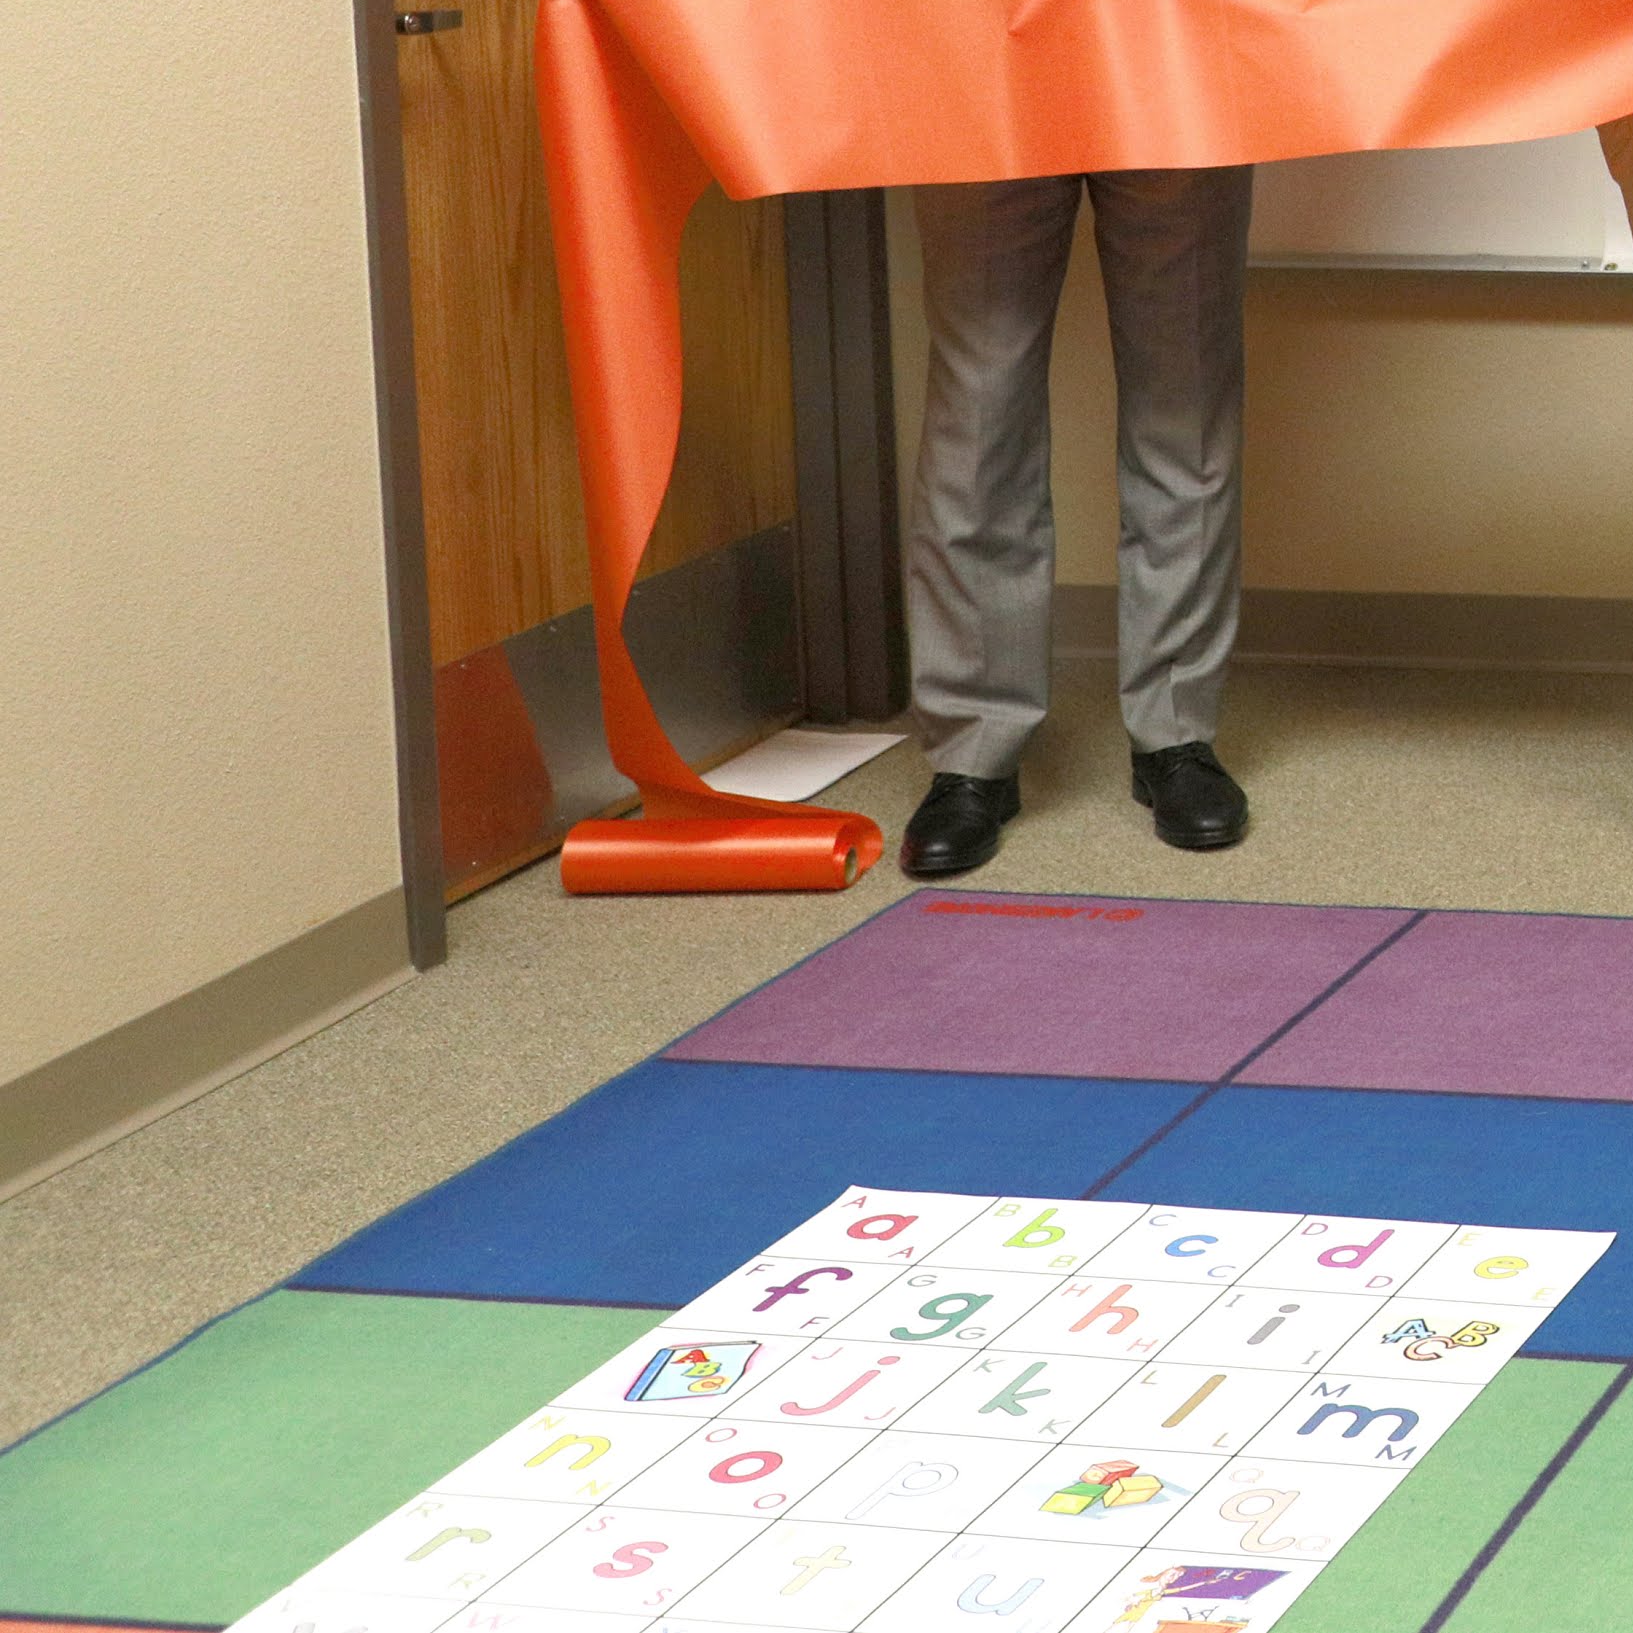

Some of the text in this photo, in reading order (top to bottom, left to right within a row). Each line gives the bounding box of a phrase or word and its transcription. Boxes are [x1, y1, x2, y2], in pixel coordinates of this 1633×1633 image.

[841, 1195, 867, 1208] A
[993, 1203, 1022, 1217] B
[846, 1213, 919, 1241] a
[1002, 1208, 1066, 1248] b
[1149, 1213, 1178, 1227] C
[1300, 1222, 1329, 1235] D
[1164, 1234, 1219, 1257] c
[1457, 1232, 1481, 1247] E
[888, 1246, 914, 1258] A
[1317, 1229, 1395, 1269] d
[1048, 1254, 1078, 1267] B
[1473, 1255, 1529, 1280] e
[745, 1263, 775, 1276] F
[1207, 1265, 1236, 1278] C
[752, 1266, 854, 1312] f
[907, 1274, 938, 1287] G
[1365, 1275, 1394, 1289] D
[1061, 1283, 1093, 1297] H
[1531, 1287, 1557, 1301] E
[1069, 1283, 1140, 1335] h
[1225, 1293, 1245, 1308] I
[800, 1316, 830, 1329] F
[889, 1292, 994, 1341] g
[1247, 1304, 1300, 1345] i
[955, 1327, 987, 1340] G
[1451, 1320, 1501, 1348] B
[811, 1346, 844, 1360] J
[1126, 1337, 1159, 1353] H
[1403, 1335, 1463, 1362] C
[973, 1358, 1006, 1373] K
[1301, 1350, 1322, 1365] I
[780, 1355, 901, 1416] j
[1140, 1370, 1158, 1385] L
[978, 1361, 1051, 1416] k
[1310, 1381, 1352, 1398] M
[864, 1406, 896, 1420] J
[528, 1415, 567, 1431] N
[1037, 1418, 1072, 1435] K
[1296, 1402, 1420, 1442] m
[705, 1427, 738, 1443] O
[1212, 1432, 1229, 1448] L
[524, 1434, 612, 1471] n
[1374, 1443, 1418, 1461] M
[708, 1450, 784, 1484] o
[575, 1479, 613, 1496] N
[844, 1461, 959, 1520] p
[406, 1501, 445, 1518] R
[753, 1493, 787, 1509] O
[585, 1515, 616, 1532] S
[1219, 1488, 1301, 1553] q
[404, 1526, 492, 1562] r
[593, 1540, 669, 1579] s
[780, 1545, 852, 1596] t
[447, 1572, 486, 1590] R
[642, 1588, 673, 1606] S
[957, 1573, 1045, 1616] u
